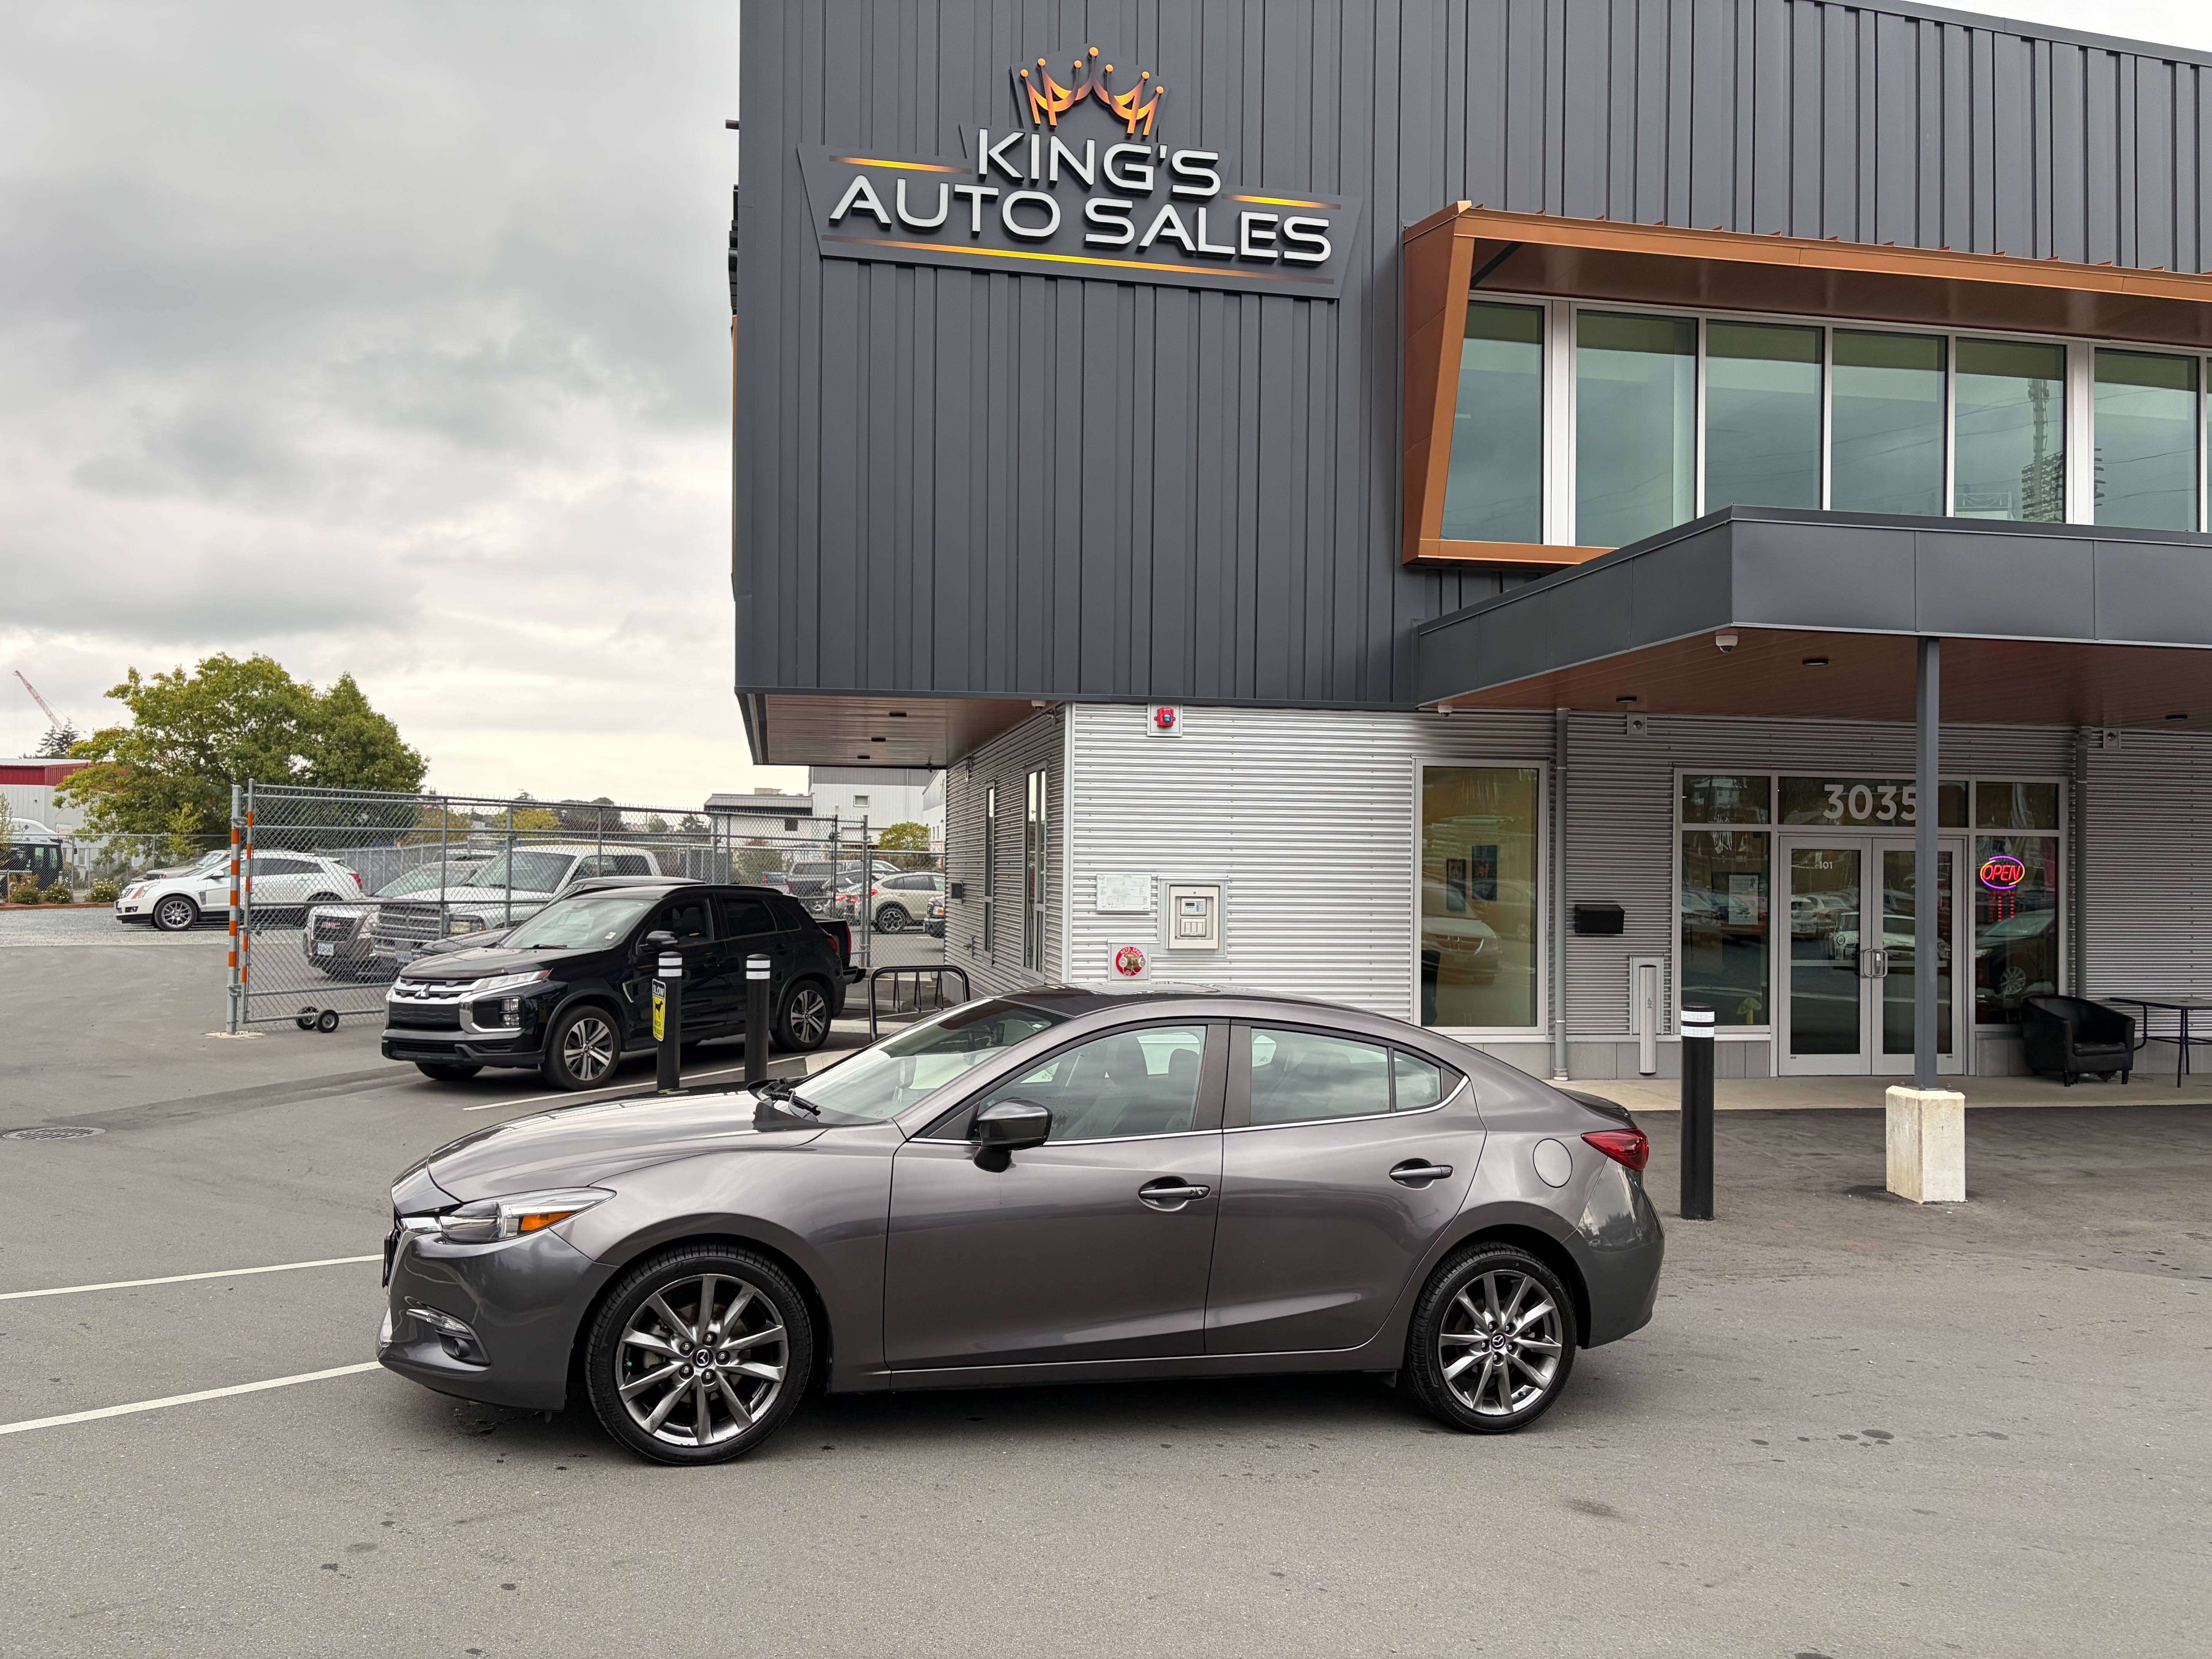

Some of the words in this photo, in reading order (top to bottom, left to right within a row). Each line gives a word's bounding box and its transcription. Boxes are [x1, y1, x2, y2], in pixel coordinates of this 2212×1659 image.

[978, 128, 1221, 198] KING'S
[829, 175, 1061, 238] AUTO
[1084, 197, 1332, 263] SALES
[1822, 784, 1916, 821] 3035
[1819, 861, 1832, 869] 101
[1982, 864, 2021, 881] OPEN
[653, 984, 664, 996] SLOW
